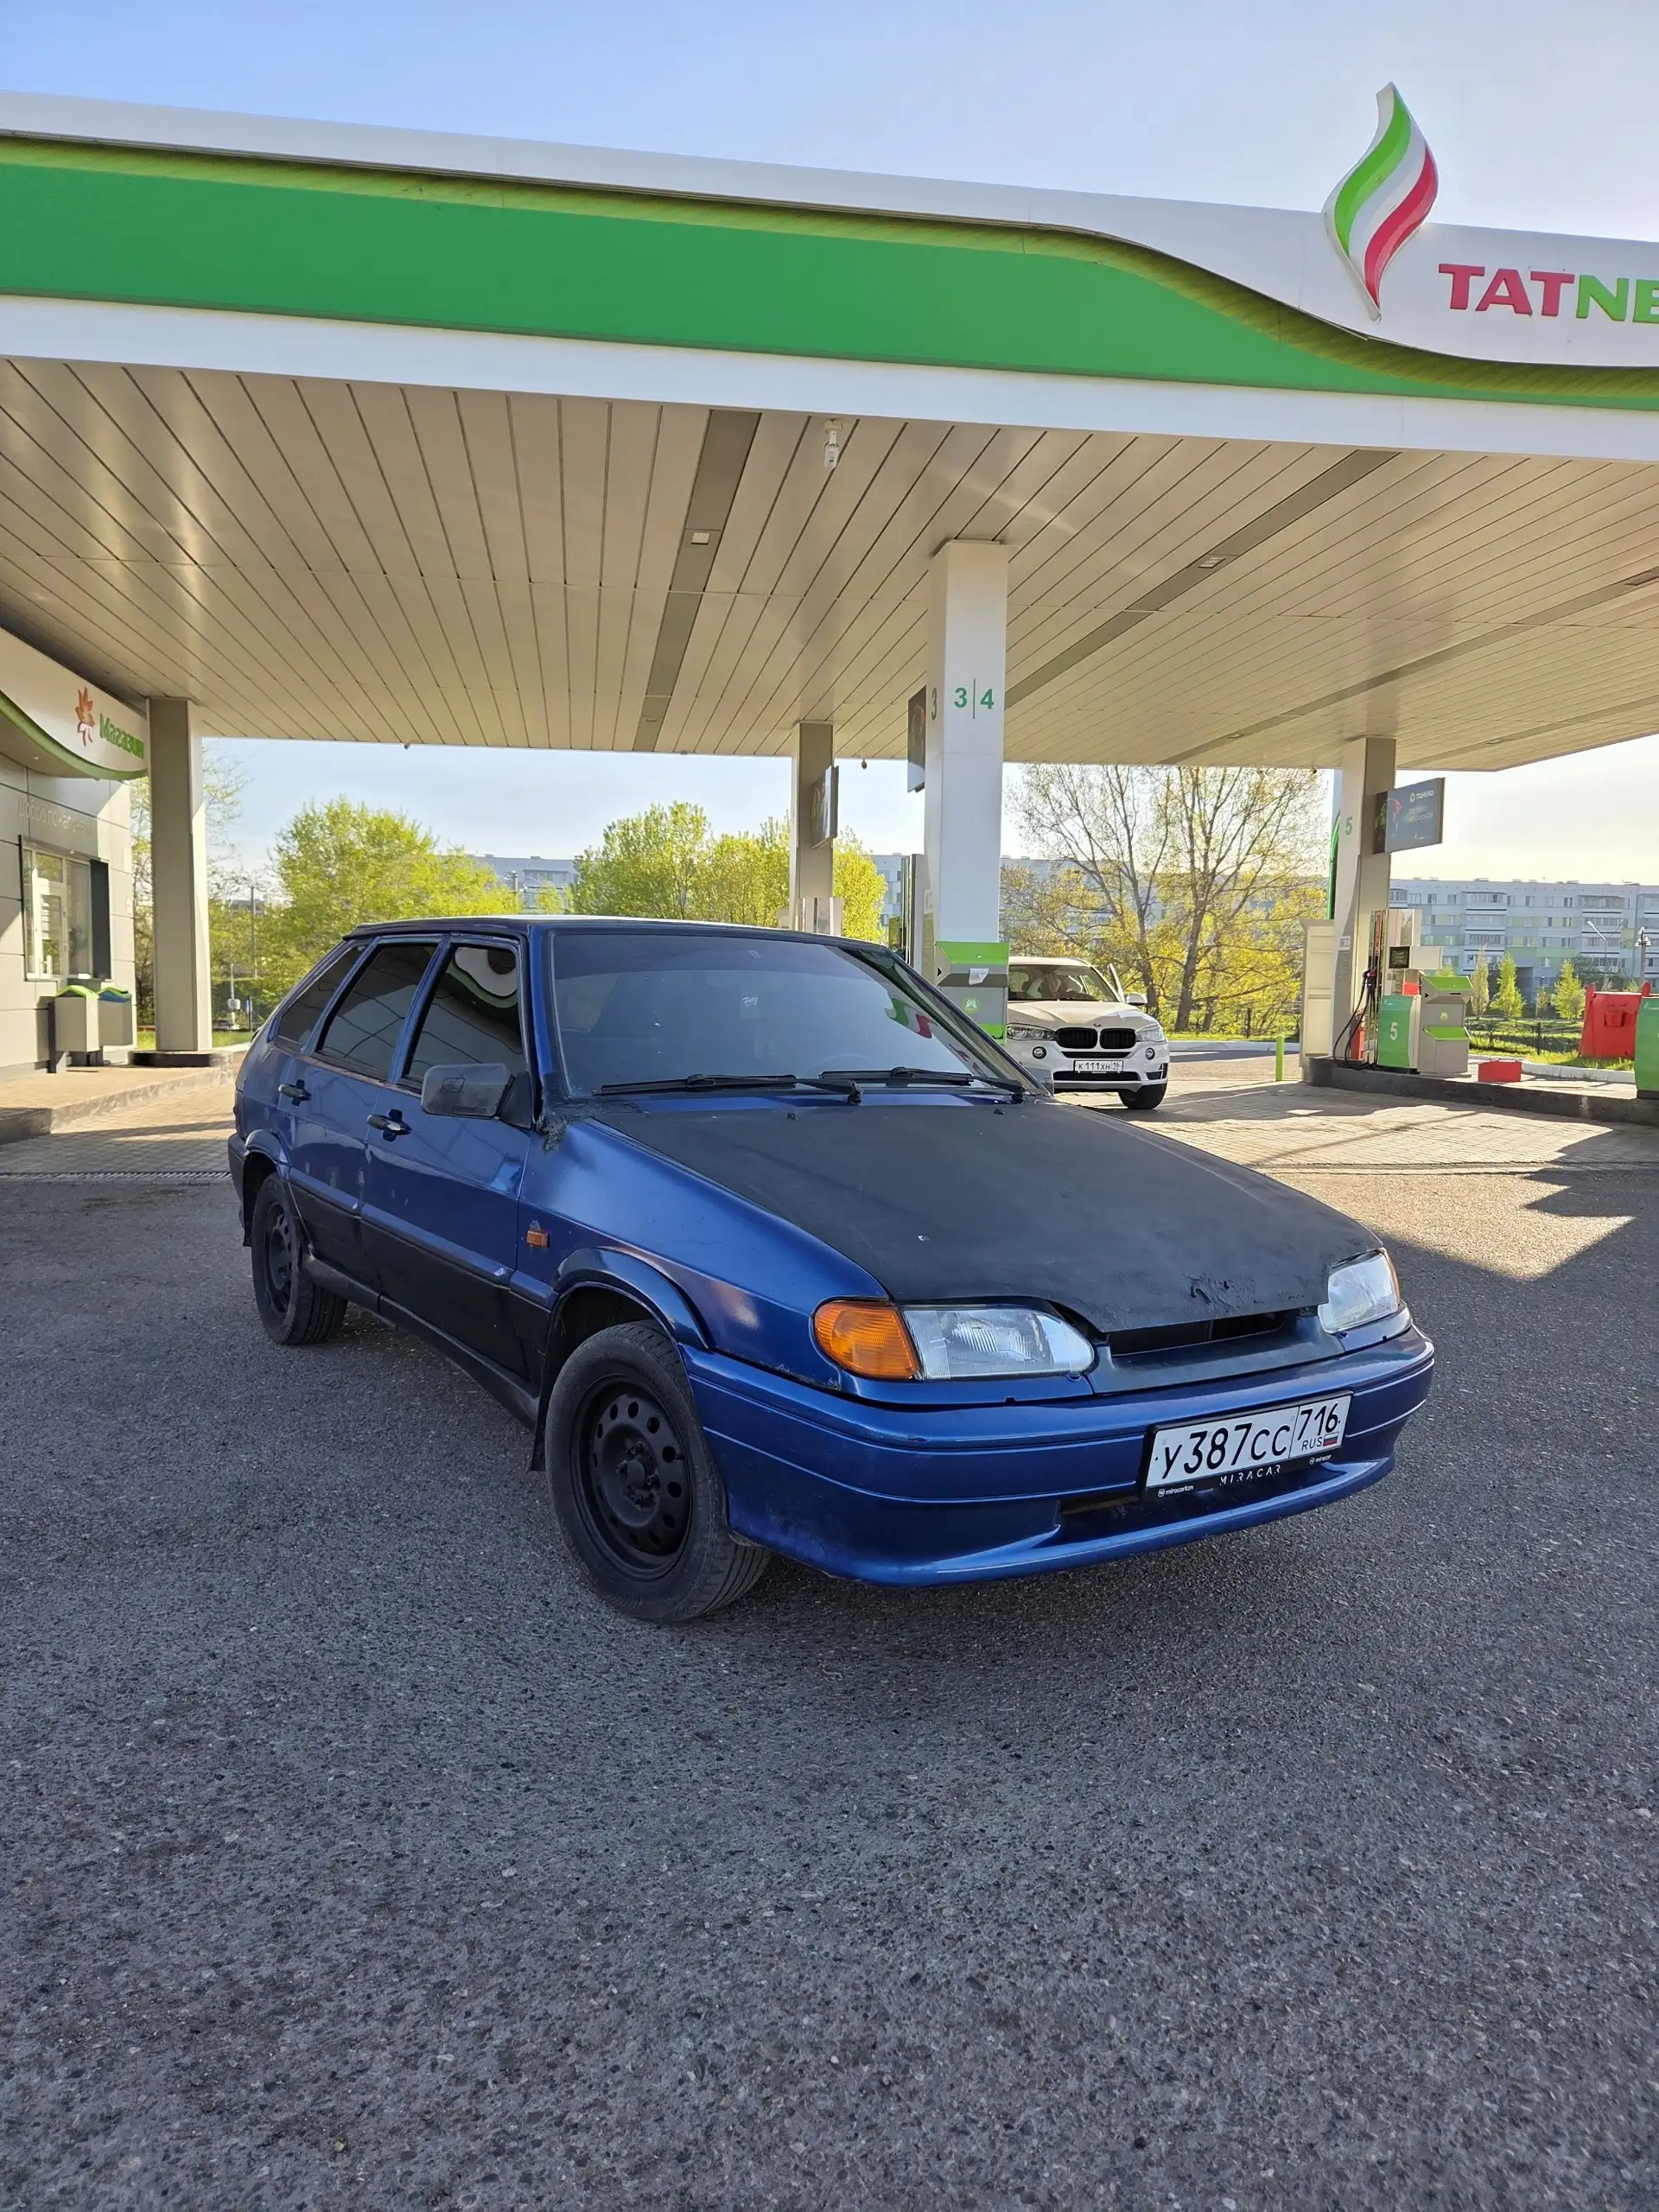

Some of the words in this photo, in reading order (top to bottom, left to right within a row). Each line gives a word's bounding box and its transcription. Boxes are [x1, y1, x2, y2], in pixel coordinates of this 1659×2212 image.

[931, 687, 938, 721] 3
[1345, 816, 1353, 836] 5
[1389, 1021, 1398, 1040] 5
[1297, 1402, 1340, 1441] 716
[1301, 1436, 1323, 1452] RUS
[1219, 1464, 1281, 1486] MIRACAR
